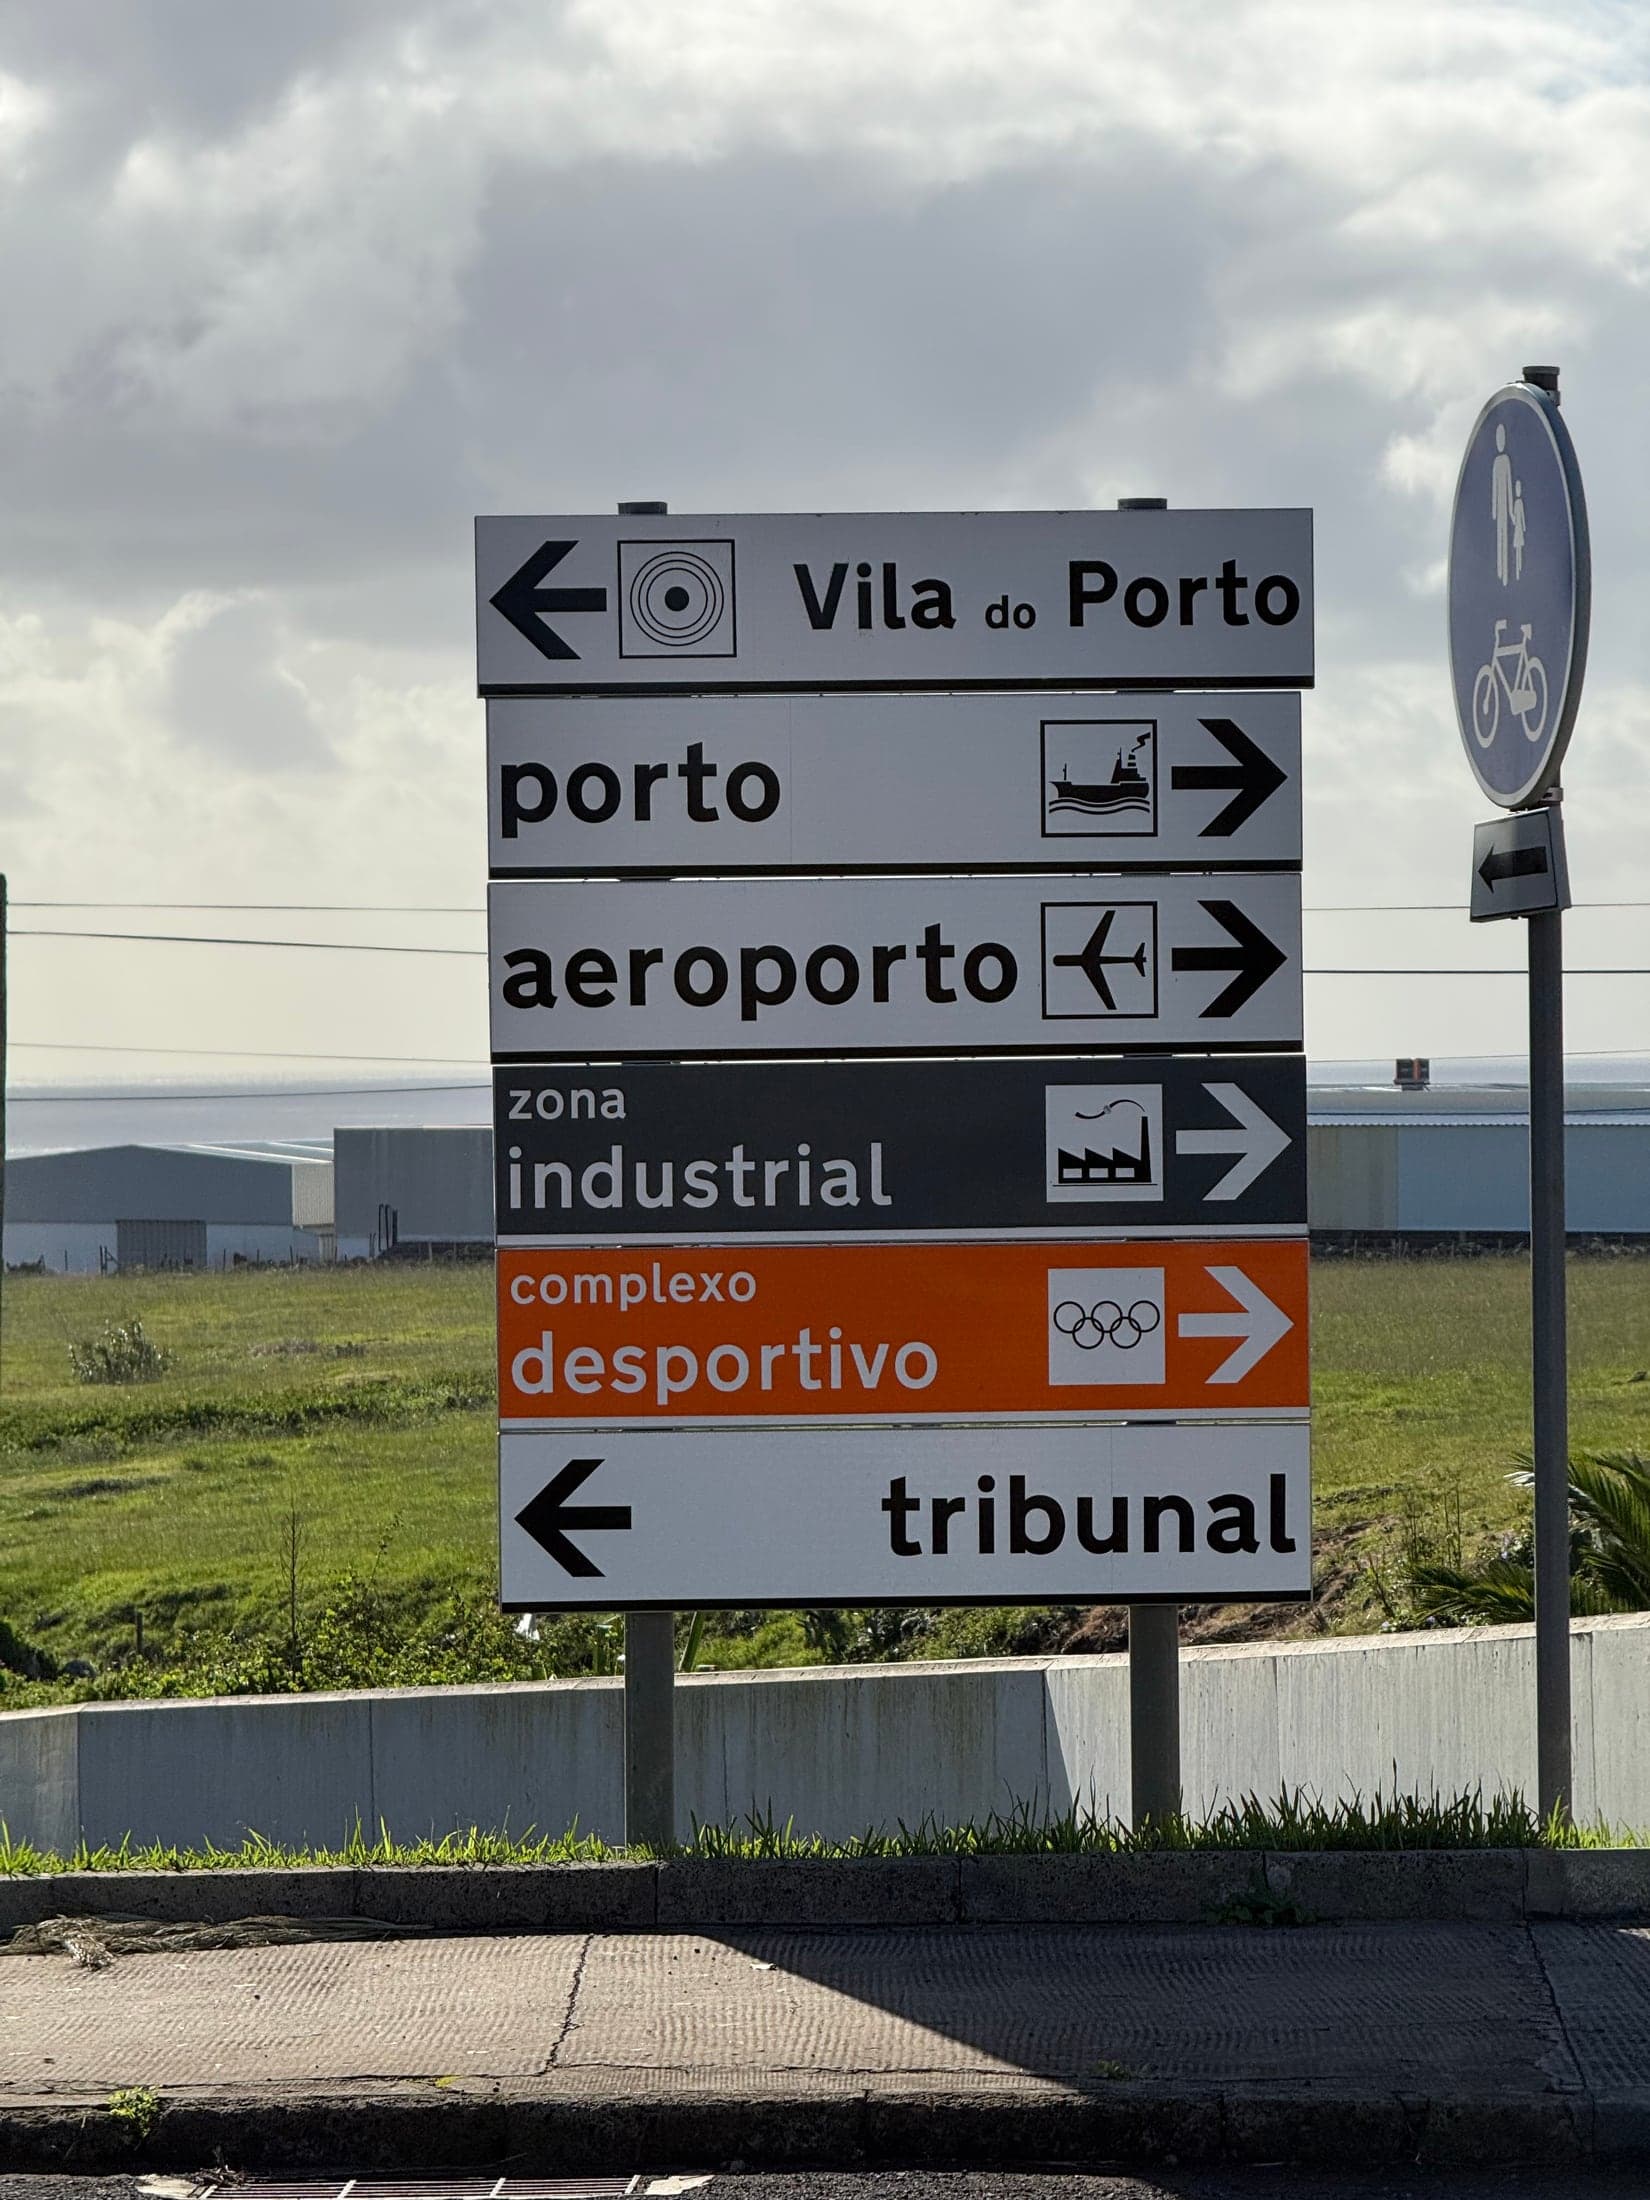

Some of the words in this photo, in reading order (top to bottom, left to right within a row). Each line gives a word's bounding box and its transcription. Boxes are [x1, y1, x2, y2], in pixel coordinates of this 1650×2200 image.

[793, 563, 956, 629] Vila
[985, 595, 1036, 629] do
[1069, 560, 1299, 627] Porto
[501, 742, 780, 838] porto
[503, 923, 1017, 1021] aeroporto
[509, 1089, 626, 1119] zona
[509, 1143, 892, 1208] industrial
[511, 1263, 756, 1311] complexo
[512, 1327, 937, 1405] desportivo
[882, 1474, 1296, 1555] tribunal
